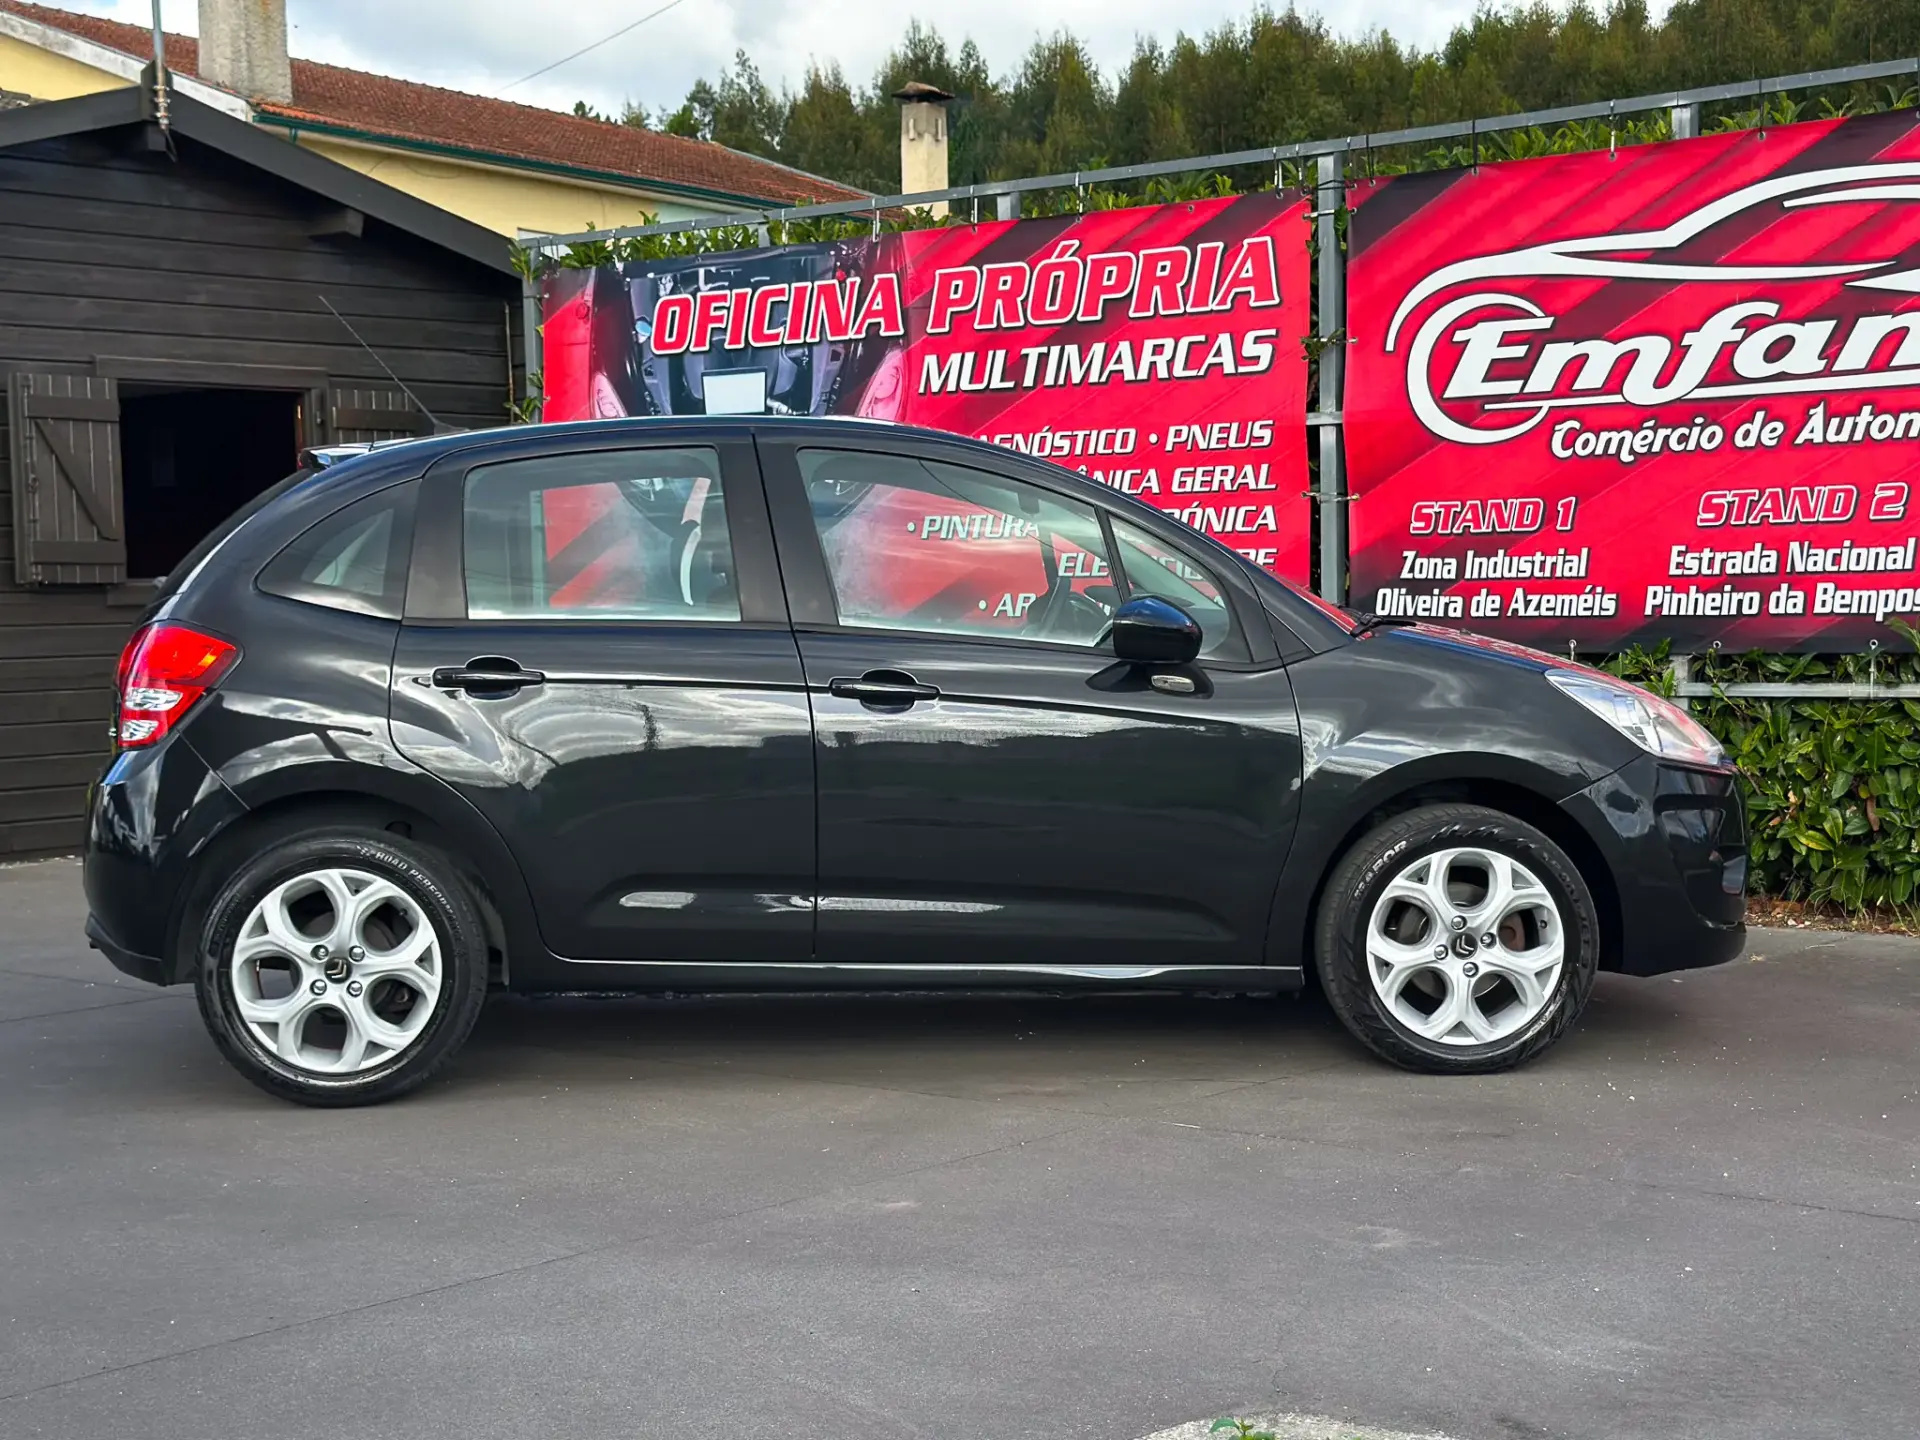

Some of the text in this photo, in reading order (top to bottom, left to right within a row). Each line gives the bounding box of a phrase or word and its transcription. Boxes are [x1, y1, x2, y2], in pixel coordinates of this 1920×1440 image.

[650, 236, 1281, 355] OFICINA PRÓPRIA
[918, 329, 1277, 392] MULTIMARCAS
[979, 420, 1273, 457] GNÓSTICO PNEUS
[1552, 417, 1723, 463] Comércio
[1734, 410, 1784, 448] de
[1075, 463, 1276, 494] NICA GERAL
[1410, 497, 1576, 533] STAND 1
[1697, 482, 1908, 526] STAND 2
[1400, 547, 1588, 579] Zona Industrial
[1668, 537, 1916, 576] Estrada Nacional
[1375, 585, 1616, 617] Oliveira de Azeméis
[1644, 584, 1760, 616] Pinheiro
[1768, 583, 1804, 614] da
